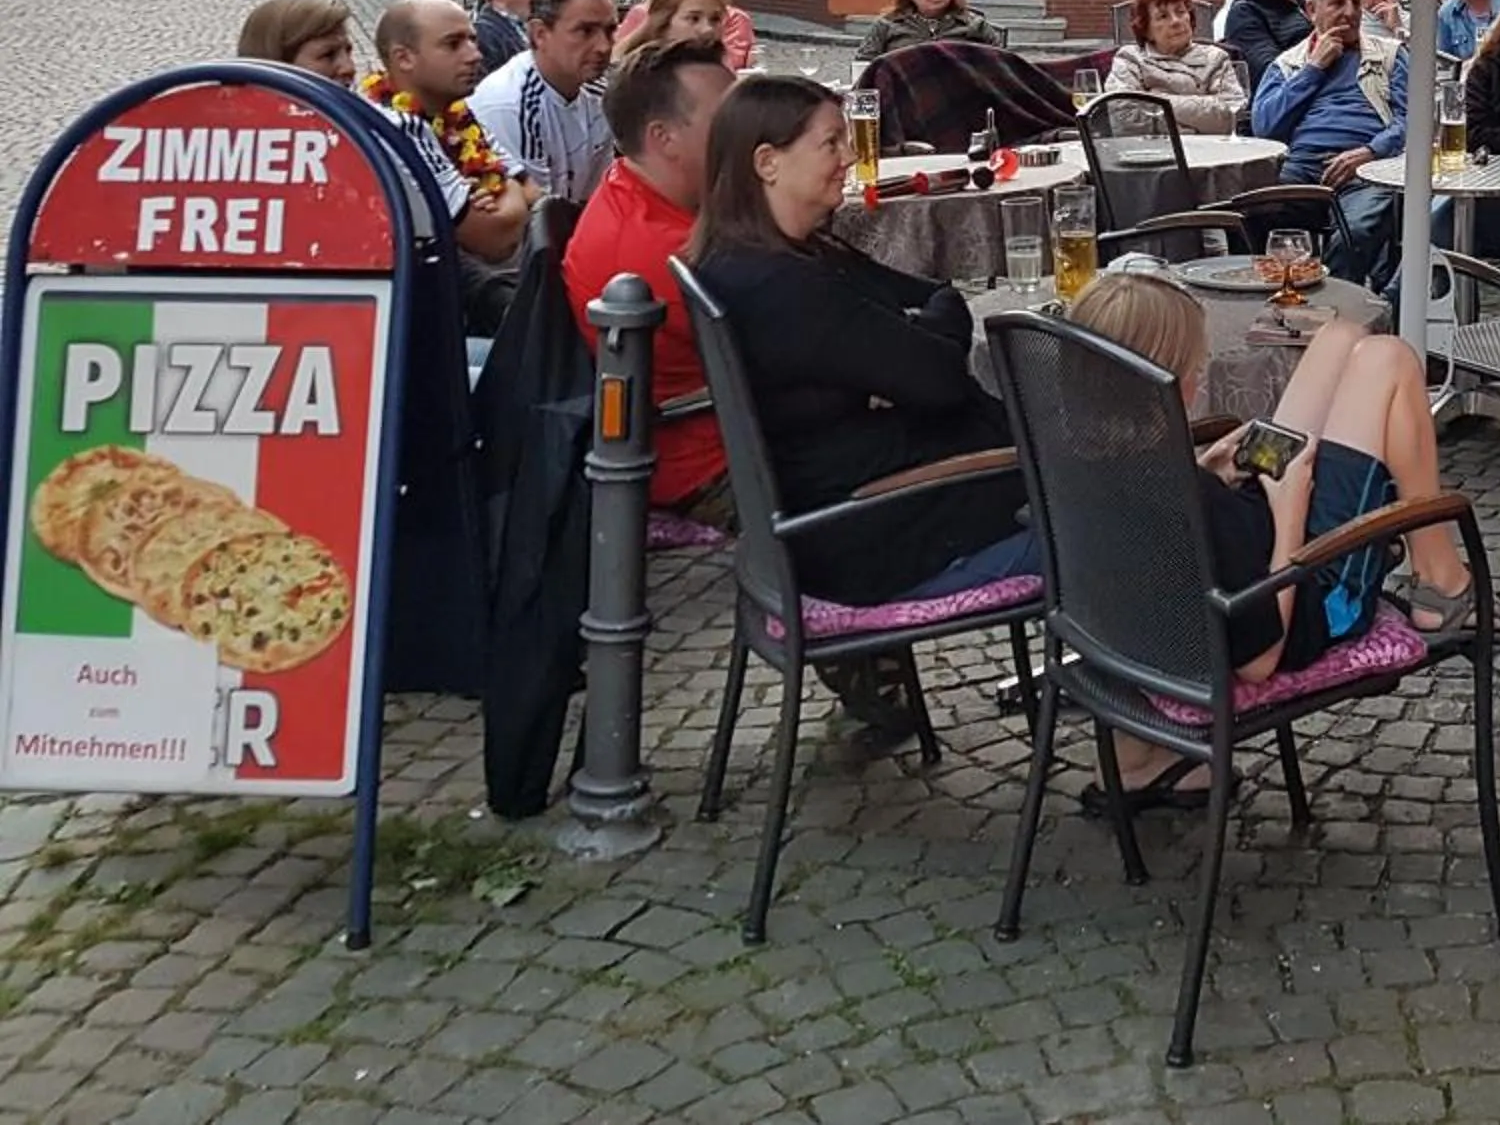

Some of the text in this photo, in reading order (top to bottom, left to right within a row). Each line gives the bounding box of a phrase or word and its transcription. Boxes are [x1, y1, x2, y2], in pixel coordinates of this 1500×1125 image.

[97, 126, 330, 184] ZIMMER
[136, 197, 286, 254] FREI
[61, 343, 341, 435] PIZZA
[77, 664, 138, 686] Auch
[88, 707, 121, 719] zum
[15, 734, 187, 762] Mitnehmen!!!
